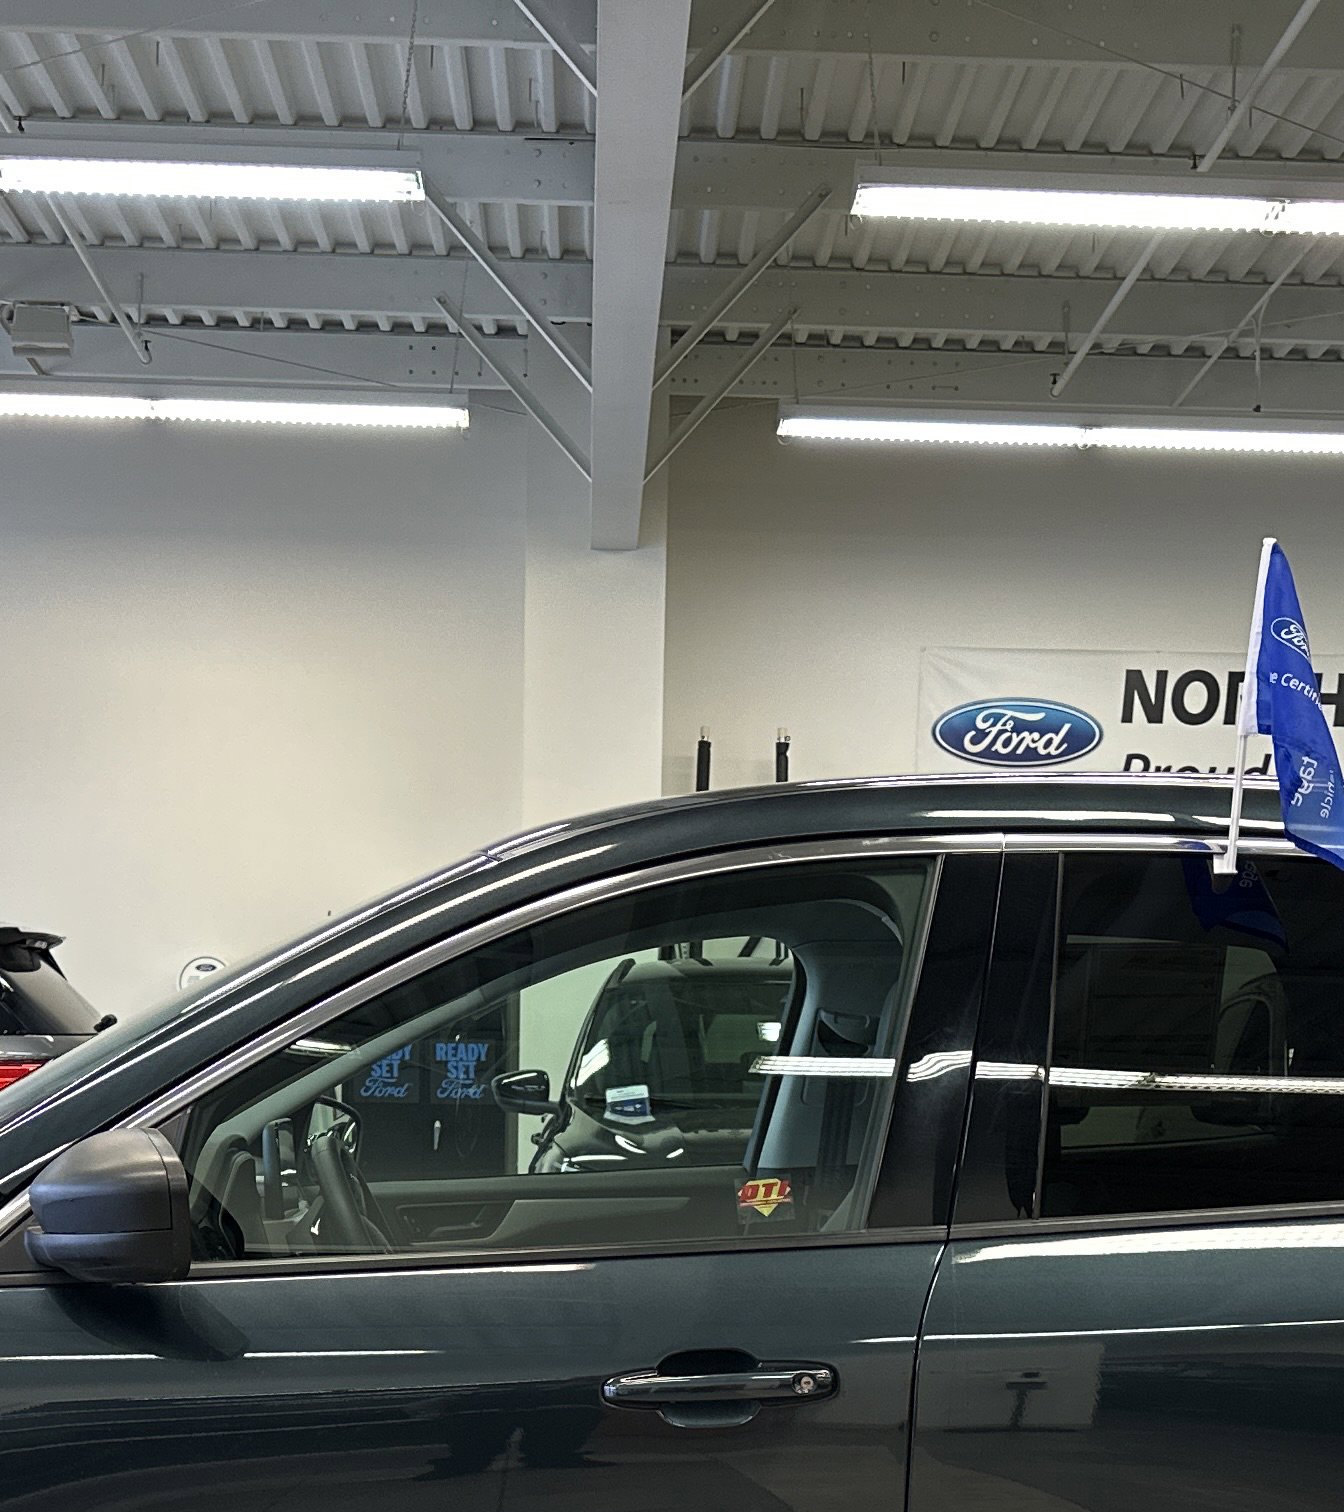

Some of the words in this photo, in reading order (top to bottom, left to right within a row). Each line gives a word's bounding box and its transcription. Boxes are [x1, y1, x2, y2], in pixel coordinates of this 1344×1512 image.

[1280, 624, 1310, 656] For
[962, 708, 1072, 756] Ford
[435, 1042, 489, 1061] READY
[371, 1060, 401, 1077] SET
[446, 1061, 477, 1079] SET
[360, 1077, 410, 1097] Ford
[436, 1079, 487, 1099] Ford
